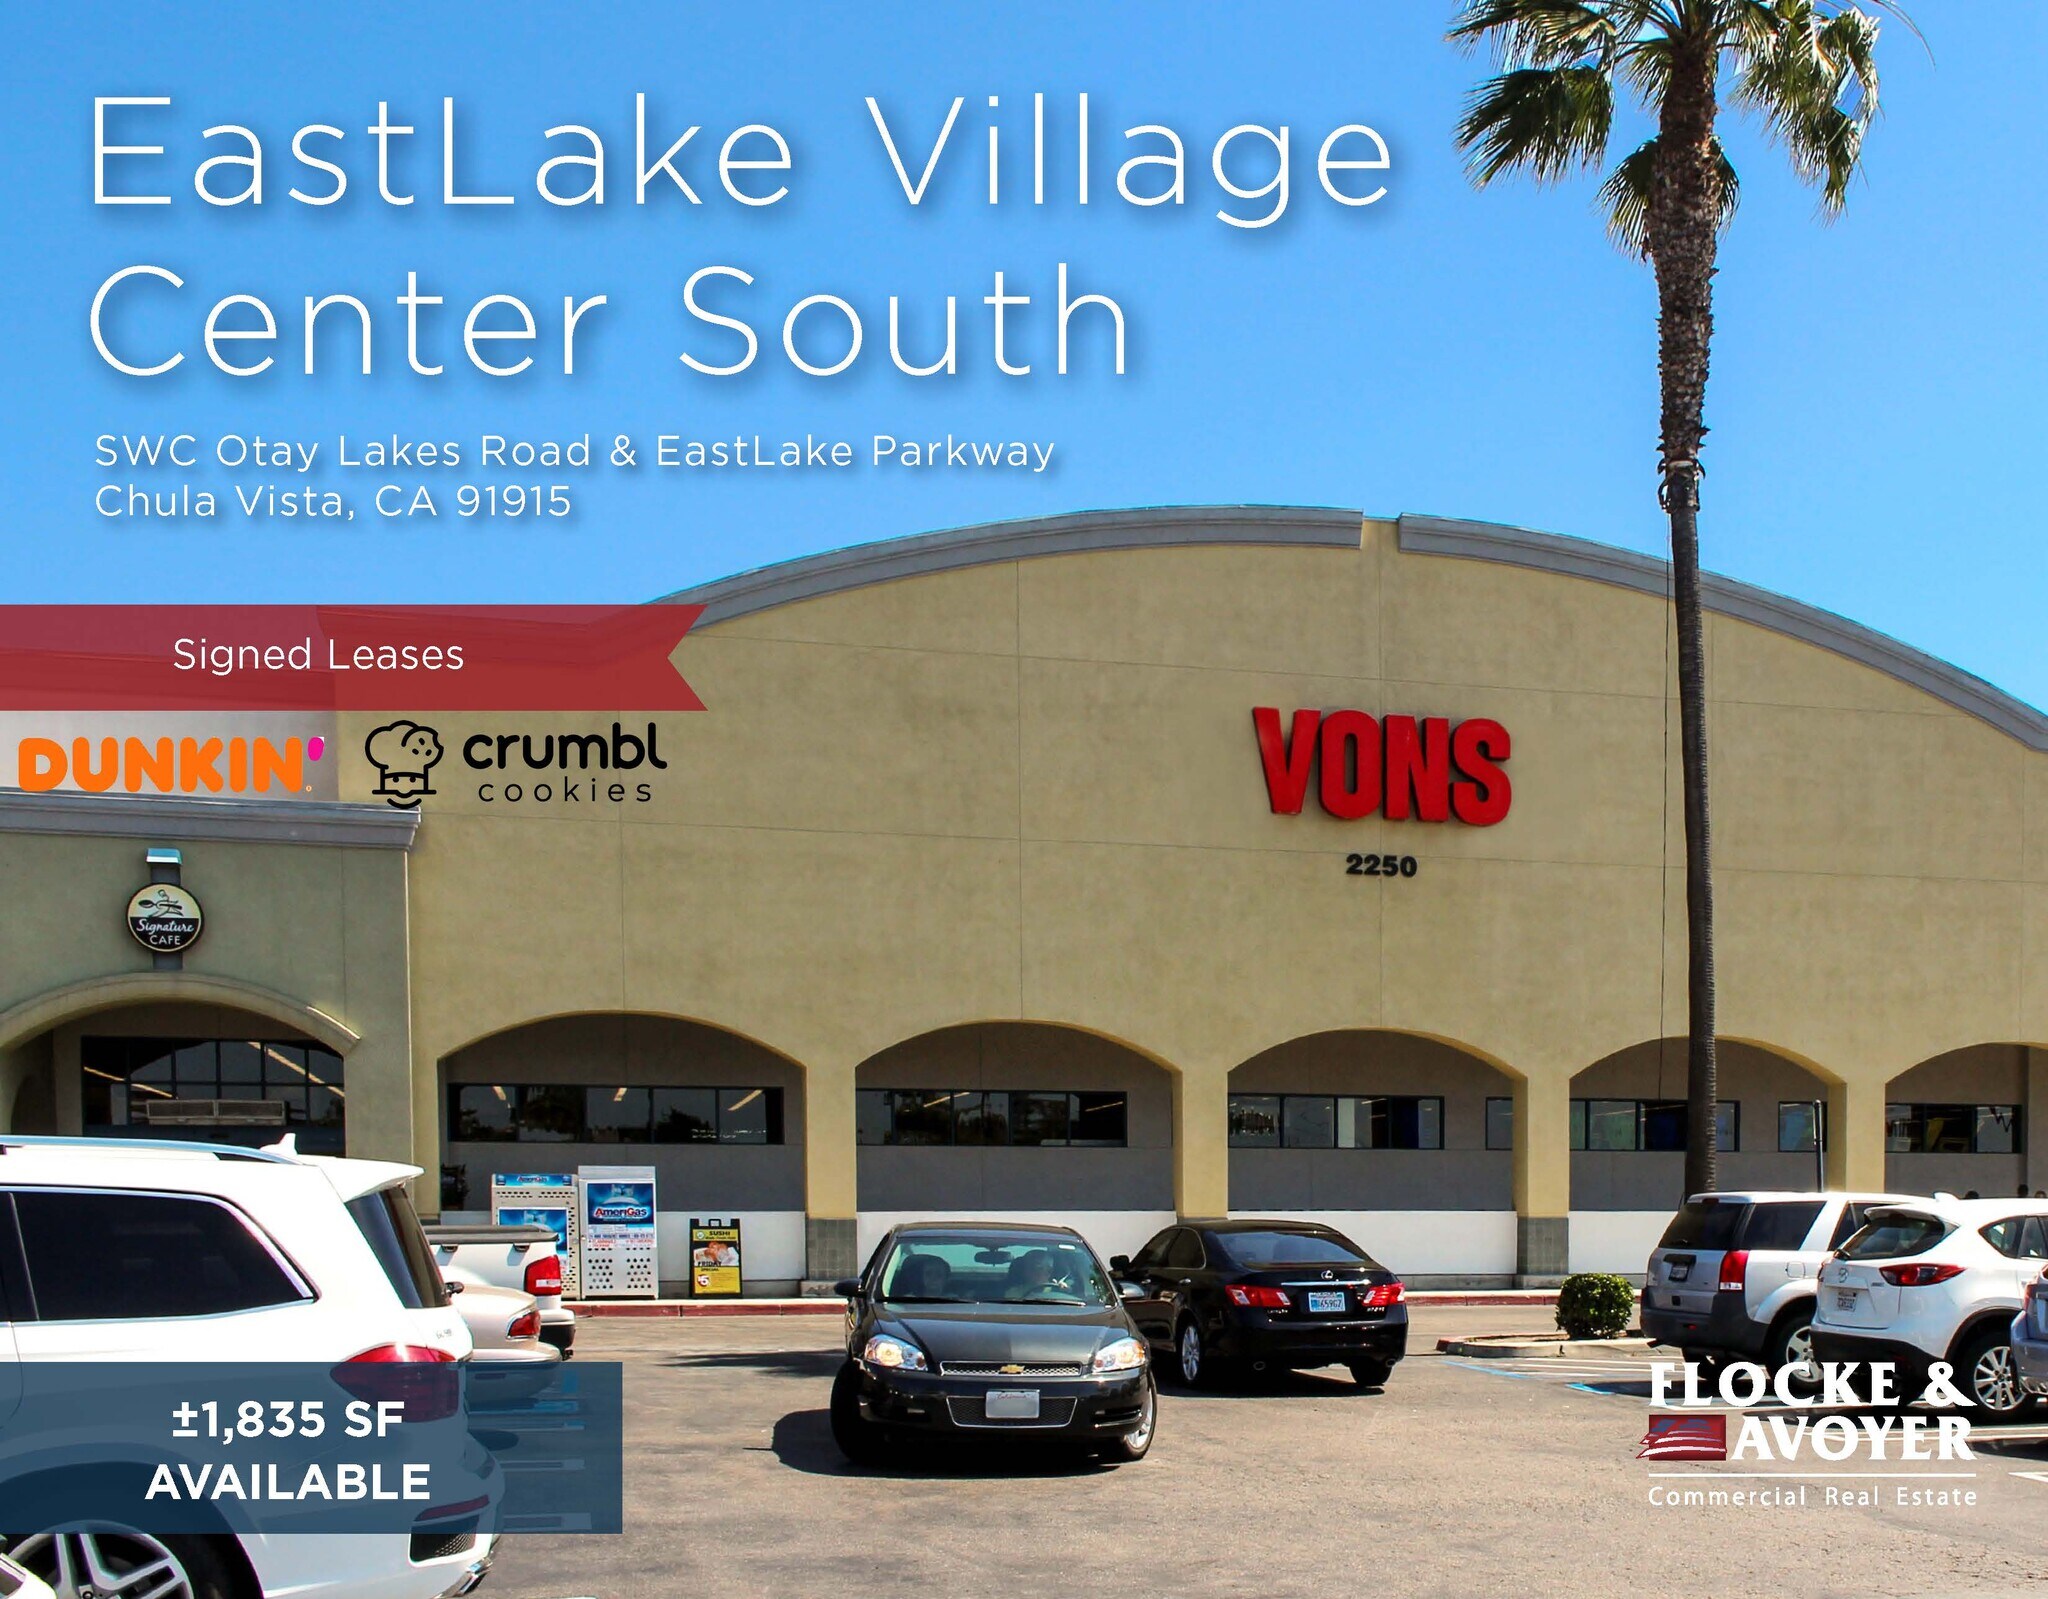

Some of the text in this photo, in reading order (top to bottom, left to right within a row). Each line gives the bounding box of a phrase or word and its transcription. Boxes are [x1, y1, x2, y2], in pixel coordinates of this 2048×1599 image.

[1252, 706, 1512, 826] VONS
[1346, 854, 1418, 876] 2250
[136, 918, 194, 935] Signature
[149, 935, 181, 945] CAFE
[594, 1207, 648, 1217] AmeriGas
